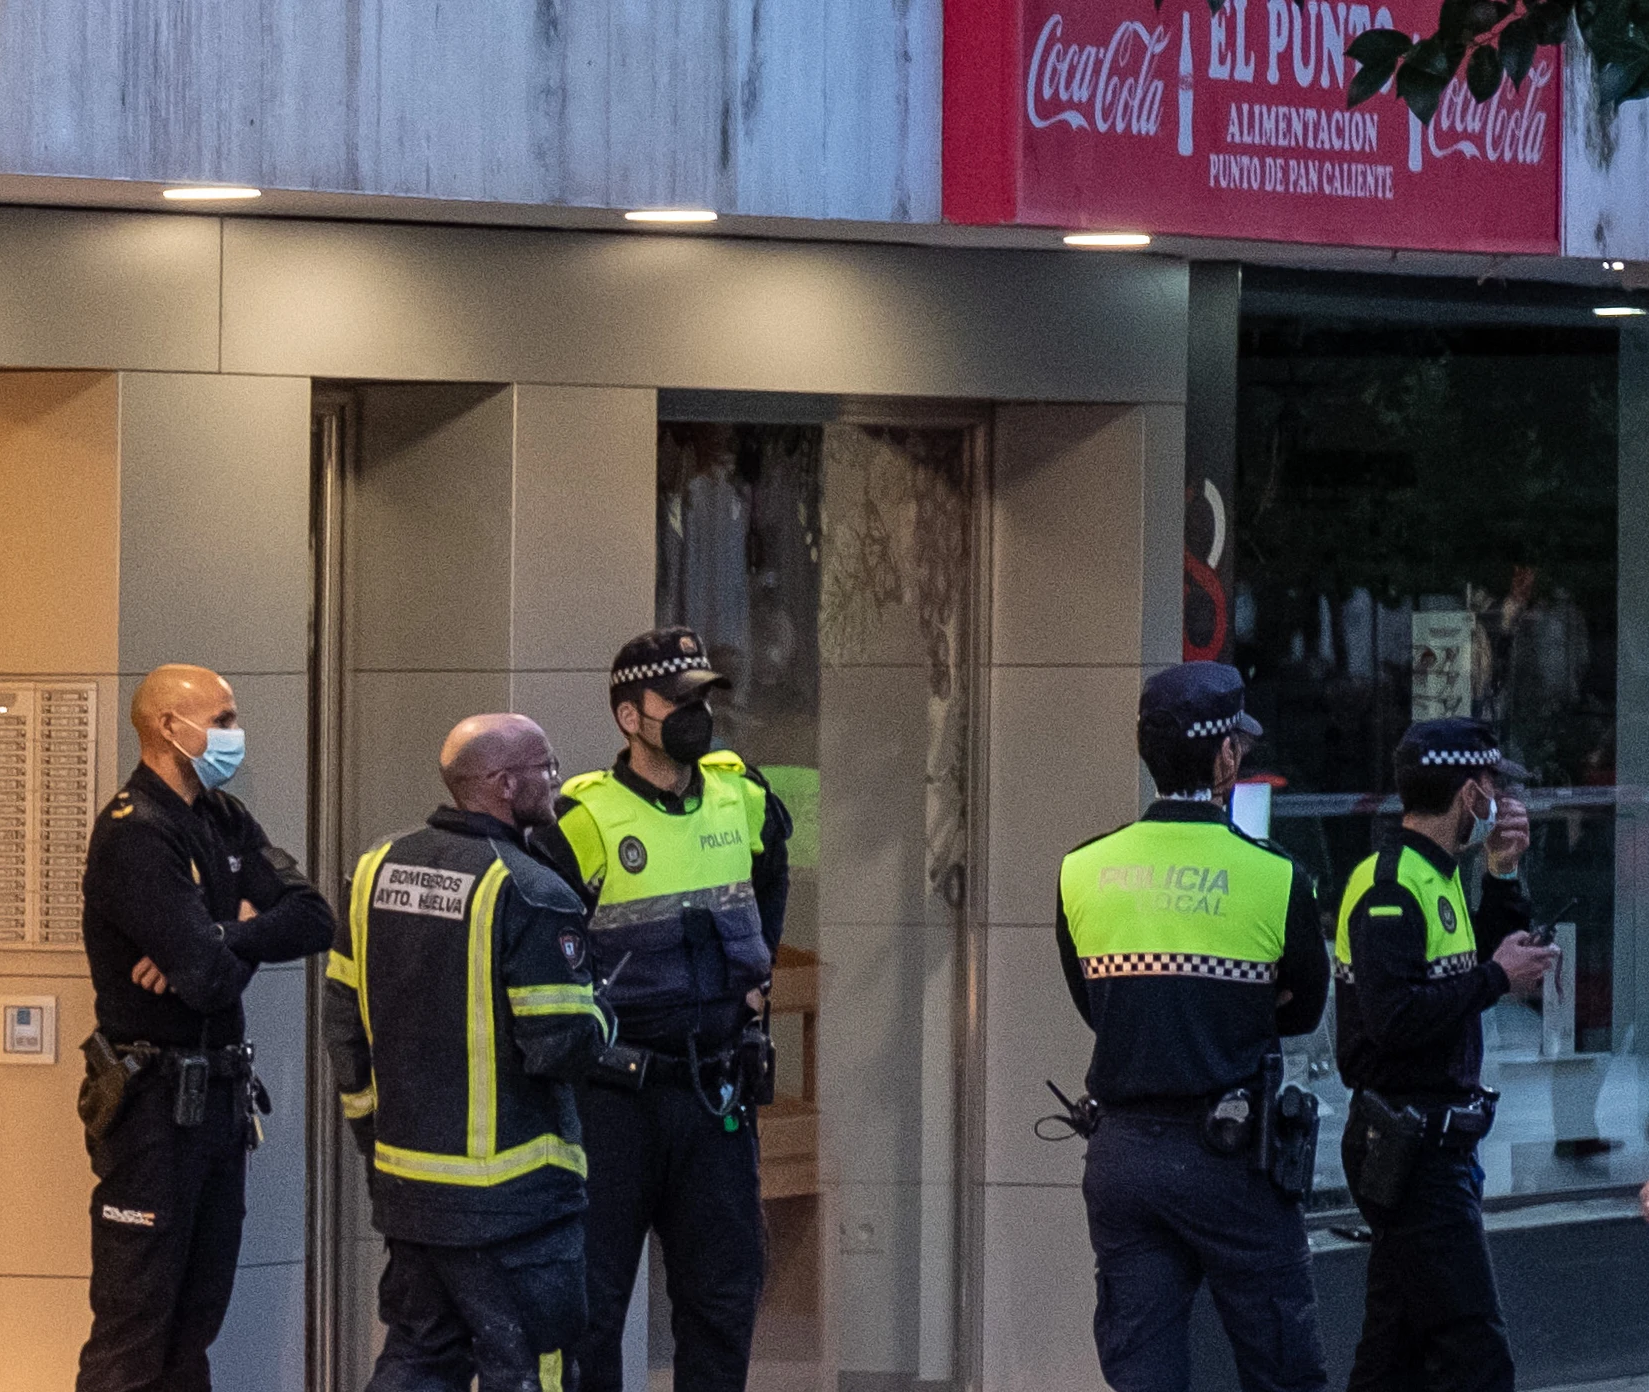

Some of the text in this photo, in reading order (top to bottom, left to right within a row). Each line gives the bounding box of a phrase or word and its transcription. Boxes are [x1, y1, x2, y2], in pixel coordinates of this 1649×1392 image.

[1209, 0, 1255, 82] EL
[1226, 102, 1379, 152] ALIMENTACION
[1209, 153, 1394, 200] PUNTO DE PAN CALIENTE
[700, 829, 743, 850] POLICIA
[389, 868, 463, 893] BOMBEROS
[1099, 864, 1230, 896] POLICIA
[375, 888, 413, 908] AYTO.
